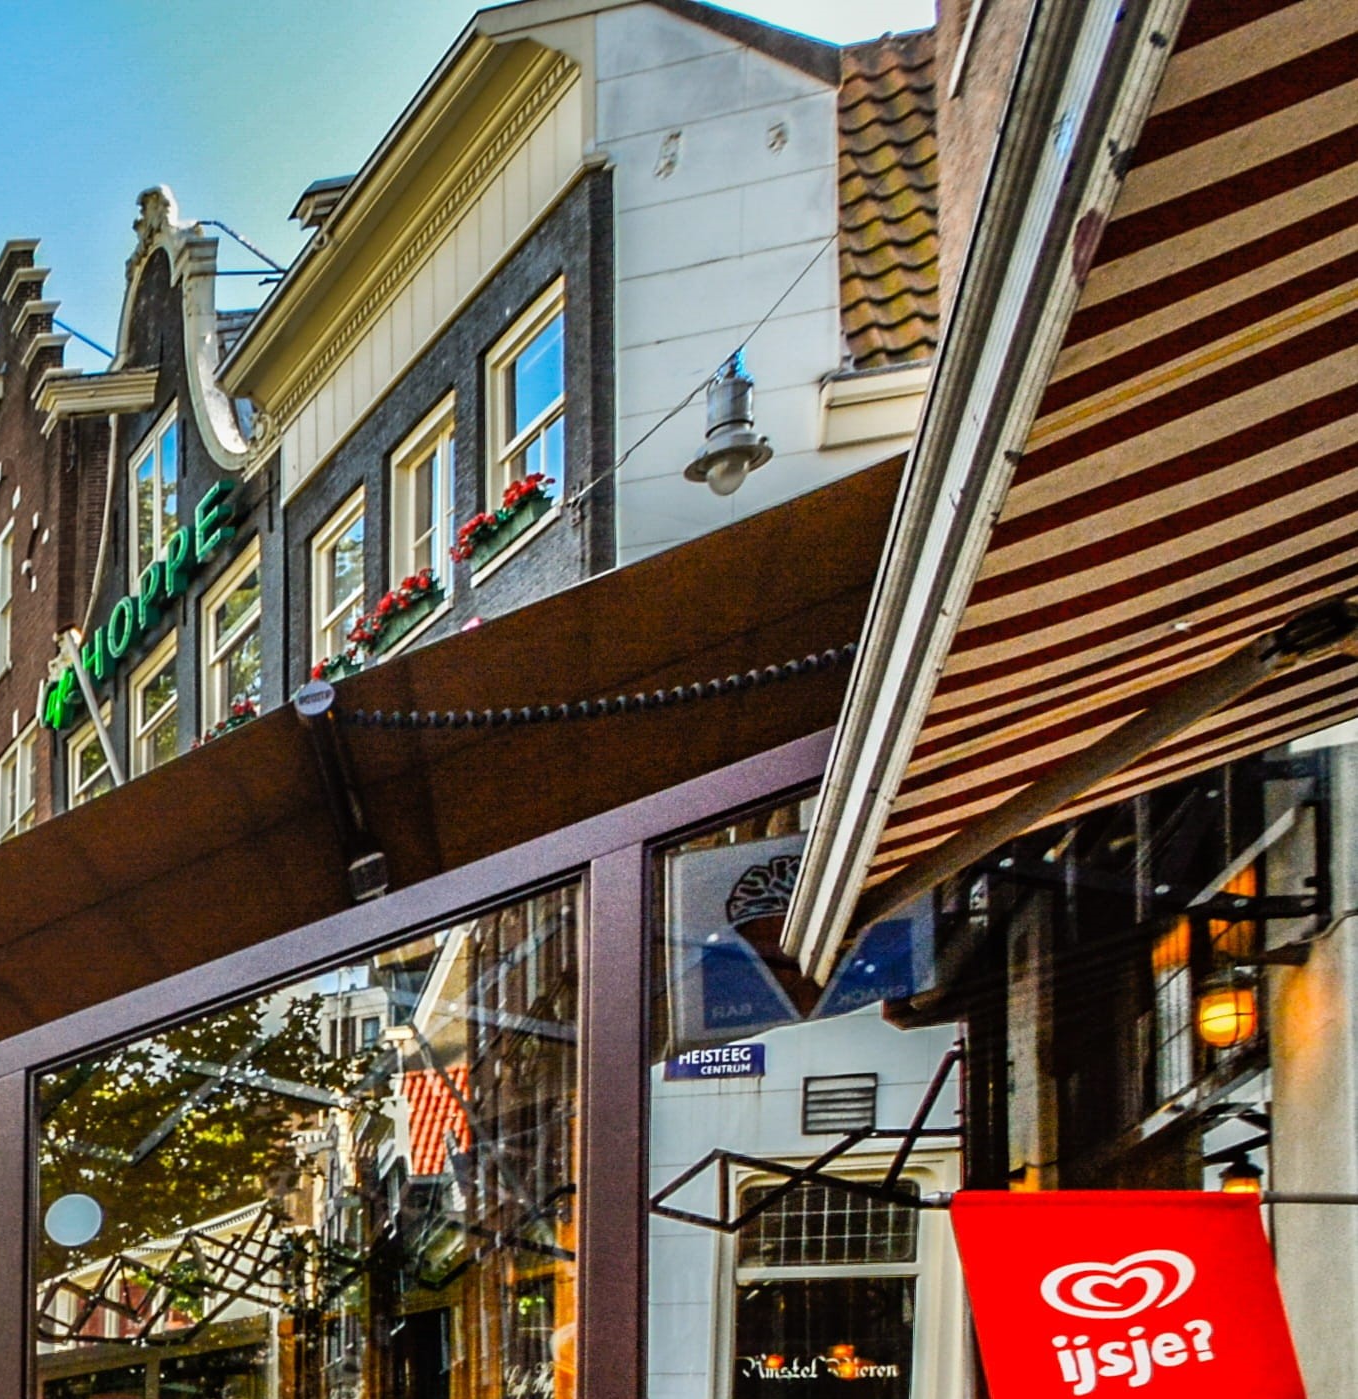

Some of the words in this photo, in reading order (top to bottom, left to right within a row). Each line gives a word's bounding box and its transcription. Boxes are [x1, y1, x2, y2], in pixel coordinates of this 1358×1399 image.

[81, 479, 237, 680] HOPPE
[679, 1046, 752, 1066] HEISTEEG
[700, 1063, 752, 1077] CENTRUM
[1051, 1319, 1216, 1396] ijsje?
